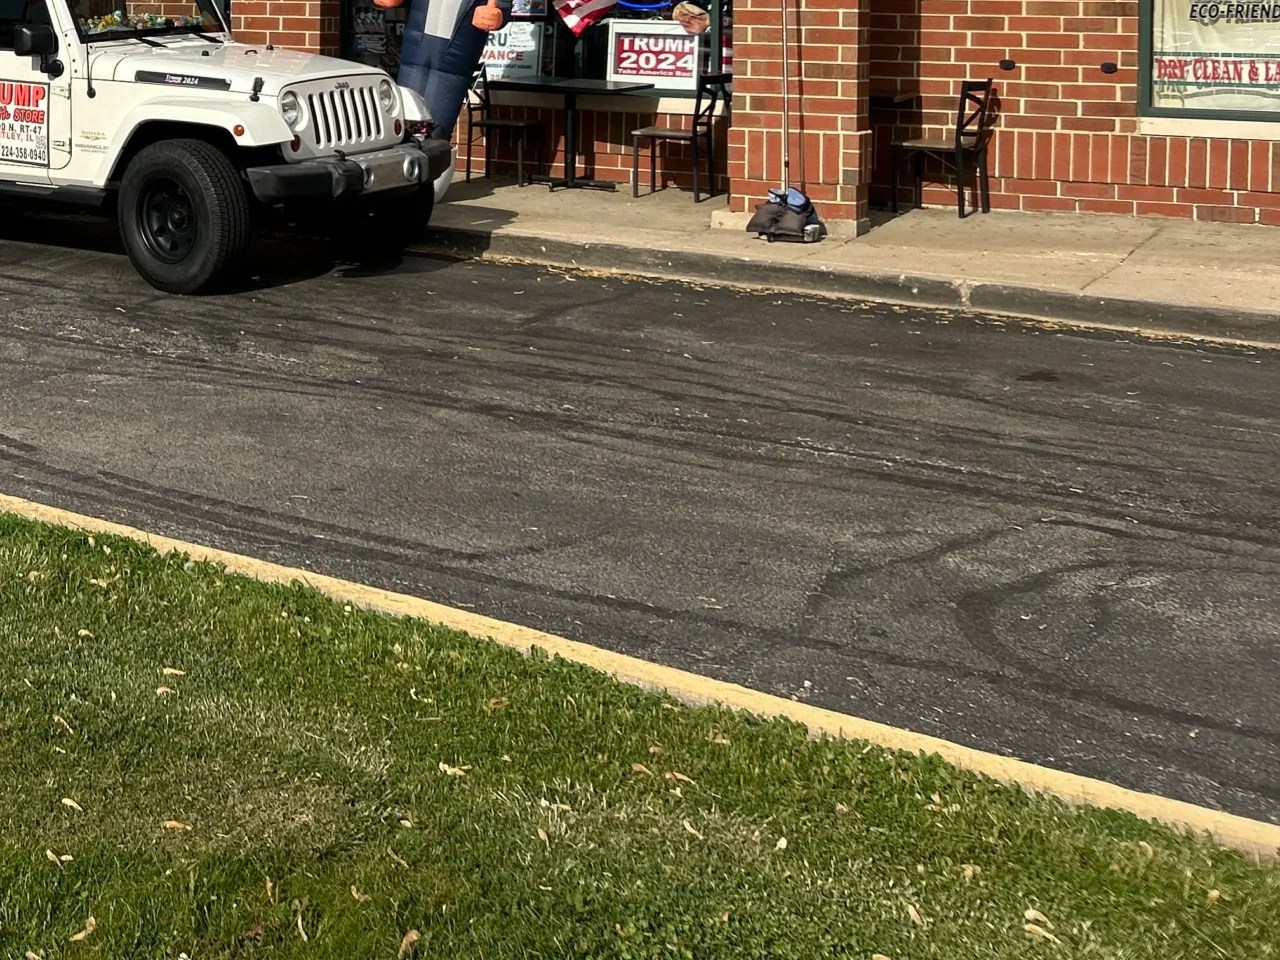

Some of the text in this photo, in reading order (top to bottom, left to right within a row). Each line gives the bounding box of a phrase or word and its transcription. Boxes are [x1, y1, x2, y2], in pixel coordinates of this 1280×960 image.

[620, 52, 694, 70] 2024
[1155, 58, 1187, 80] DRY
[1193, 58, 1243, 81] CLEAN
[1248, 60, 1259, 81] &
[183, 77, 199, 85] 2024
[13, 108, 46, 124] STORE
[20, 124, 42, 135] RT-47
[26, 134, 34, 142] IL
